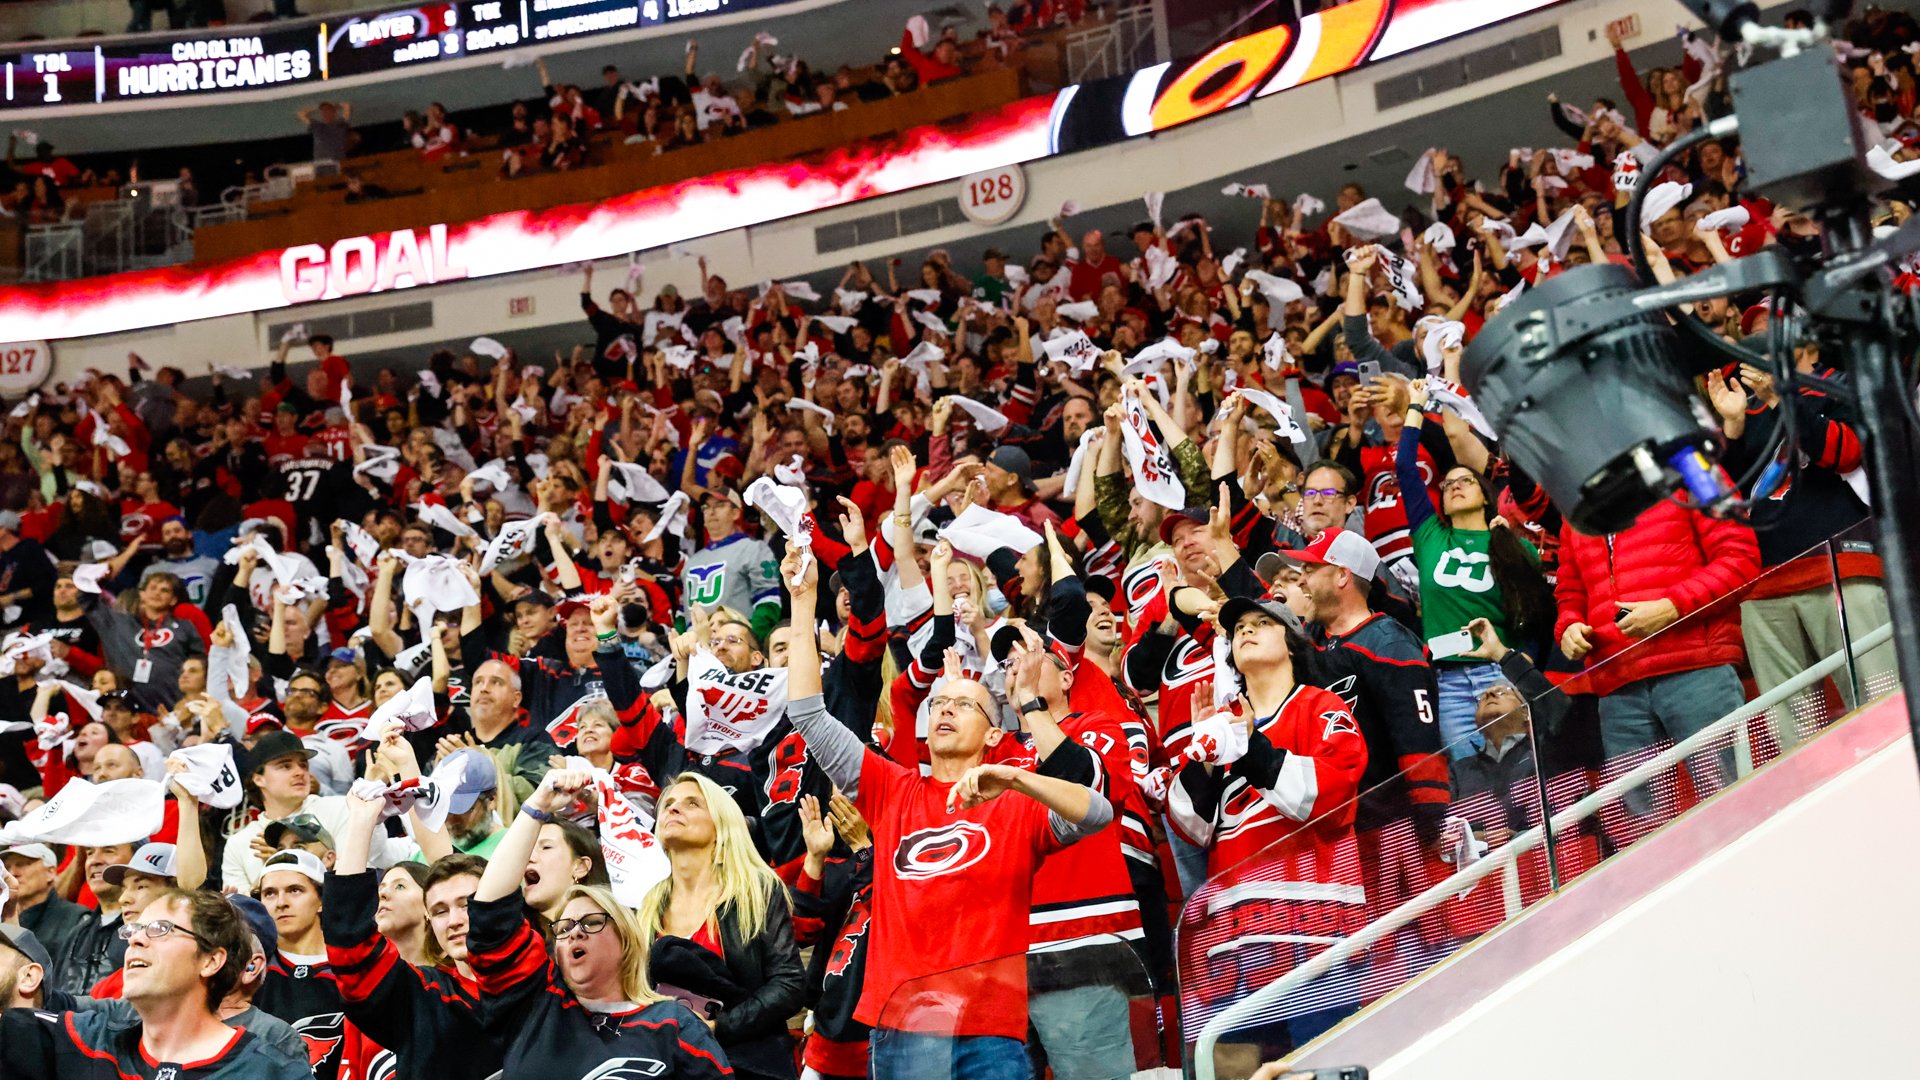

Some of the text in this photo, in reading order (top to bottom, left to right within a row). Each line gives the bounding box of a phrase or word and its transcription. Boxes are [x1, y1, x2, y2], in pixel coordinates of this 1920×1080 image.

[643, 0, 659, 20] 4
[349, 15, 414, 45] PLAYER
[444, 33, 459, 54] 3
[172, 37, 264, 62] CAROLINA
[42, 73, 63, 103] 1
[118, 50, 311, 96] HURRICANES
[970, 174, 1013, 207] 128
[278, 225, 468, 304] GOAL
[284, 470, 321, 503] 37
[698, 667, 775, 695] RAISE
[1412, 688, 1435, 725] 5
[1081, 730, 1117, 757] 37
